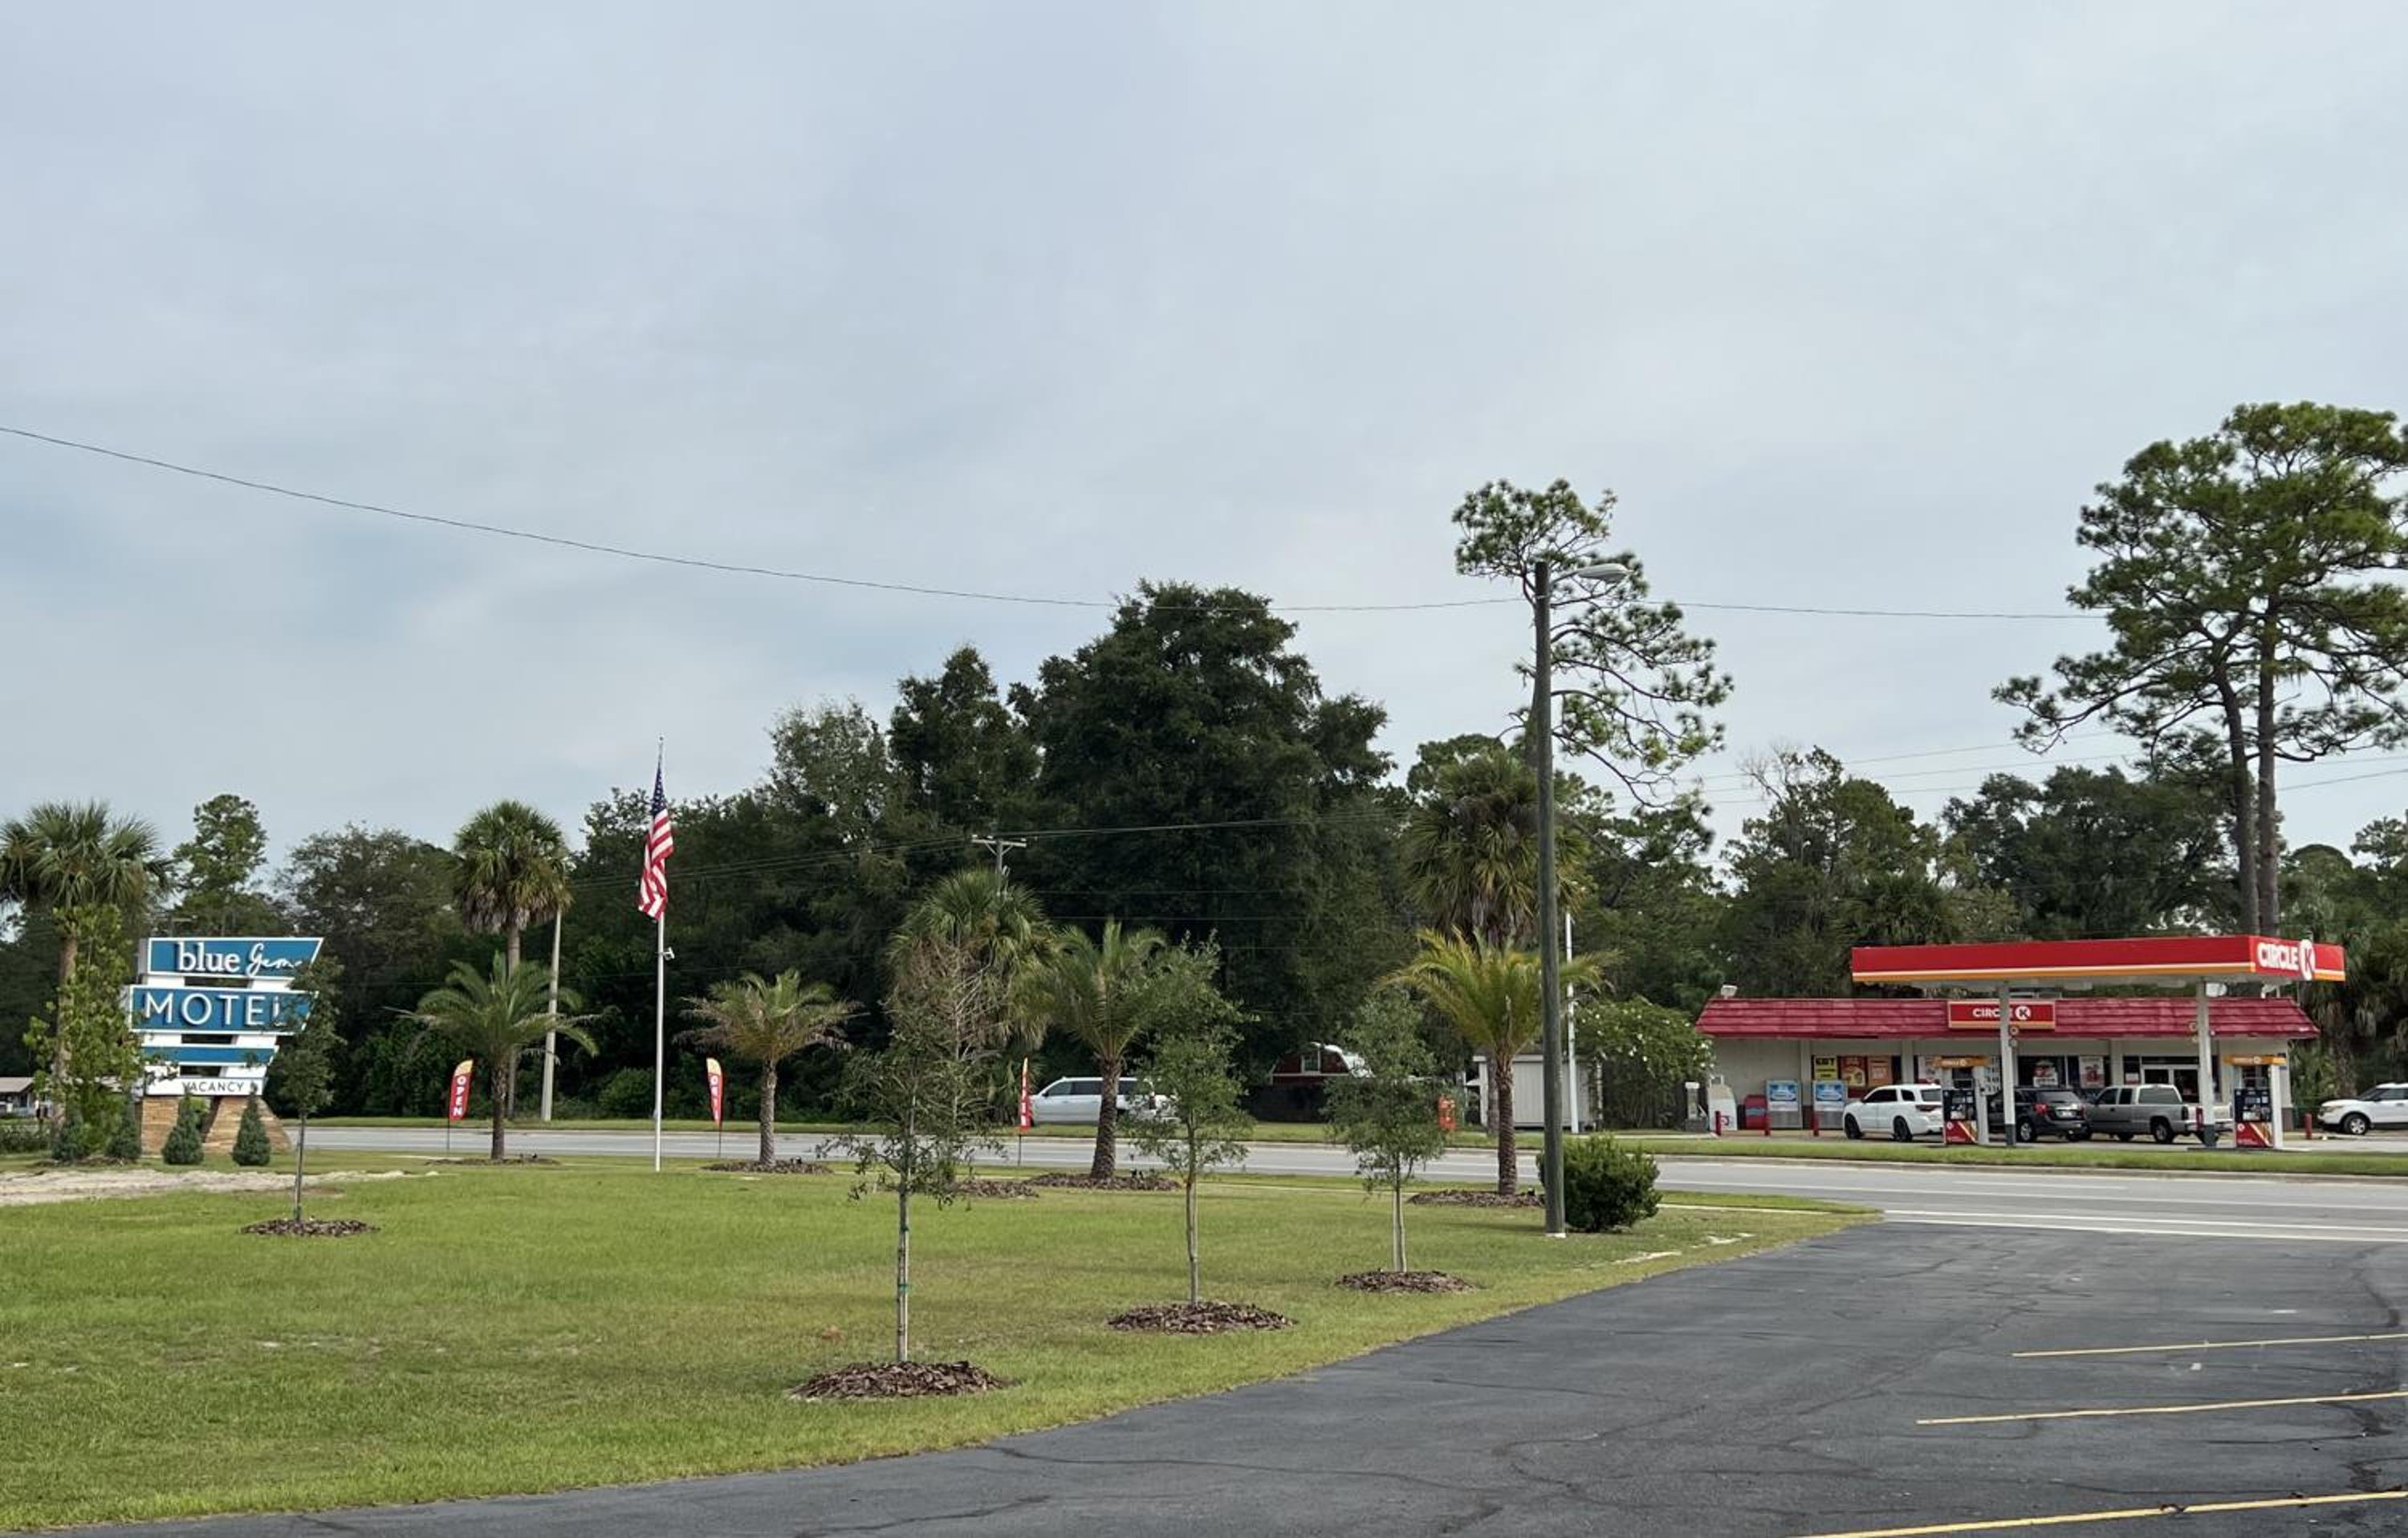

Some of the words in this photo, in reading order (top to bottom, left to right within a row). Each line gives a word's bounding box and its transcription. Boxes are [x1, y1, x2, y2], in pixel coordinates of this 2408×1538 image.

[178, 942, 240, 973] blue
[2257, 942, 2299, 970] CIRCLE
[144, 992, 287, 1026] MOTEL
[1972, 1007, 2013, 1018] CIRC
[181, 1081, 244, 1092] VACANCY
[453, 1075, 466, 1117] OPEN
